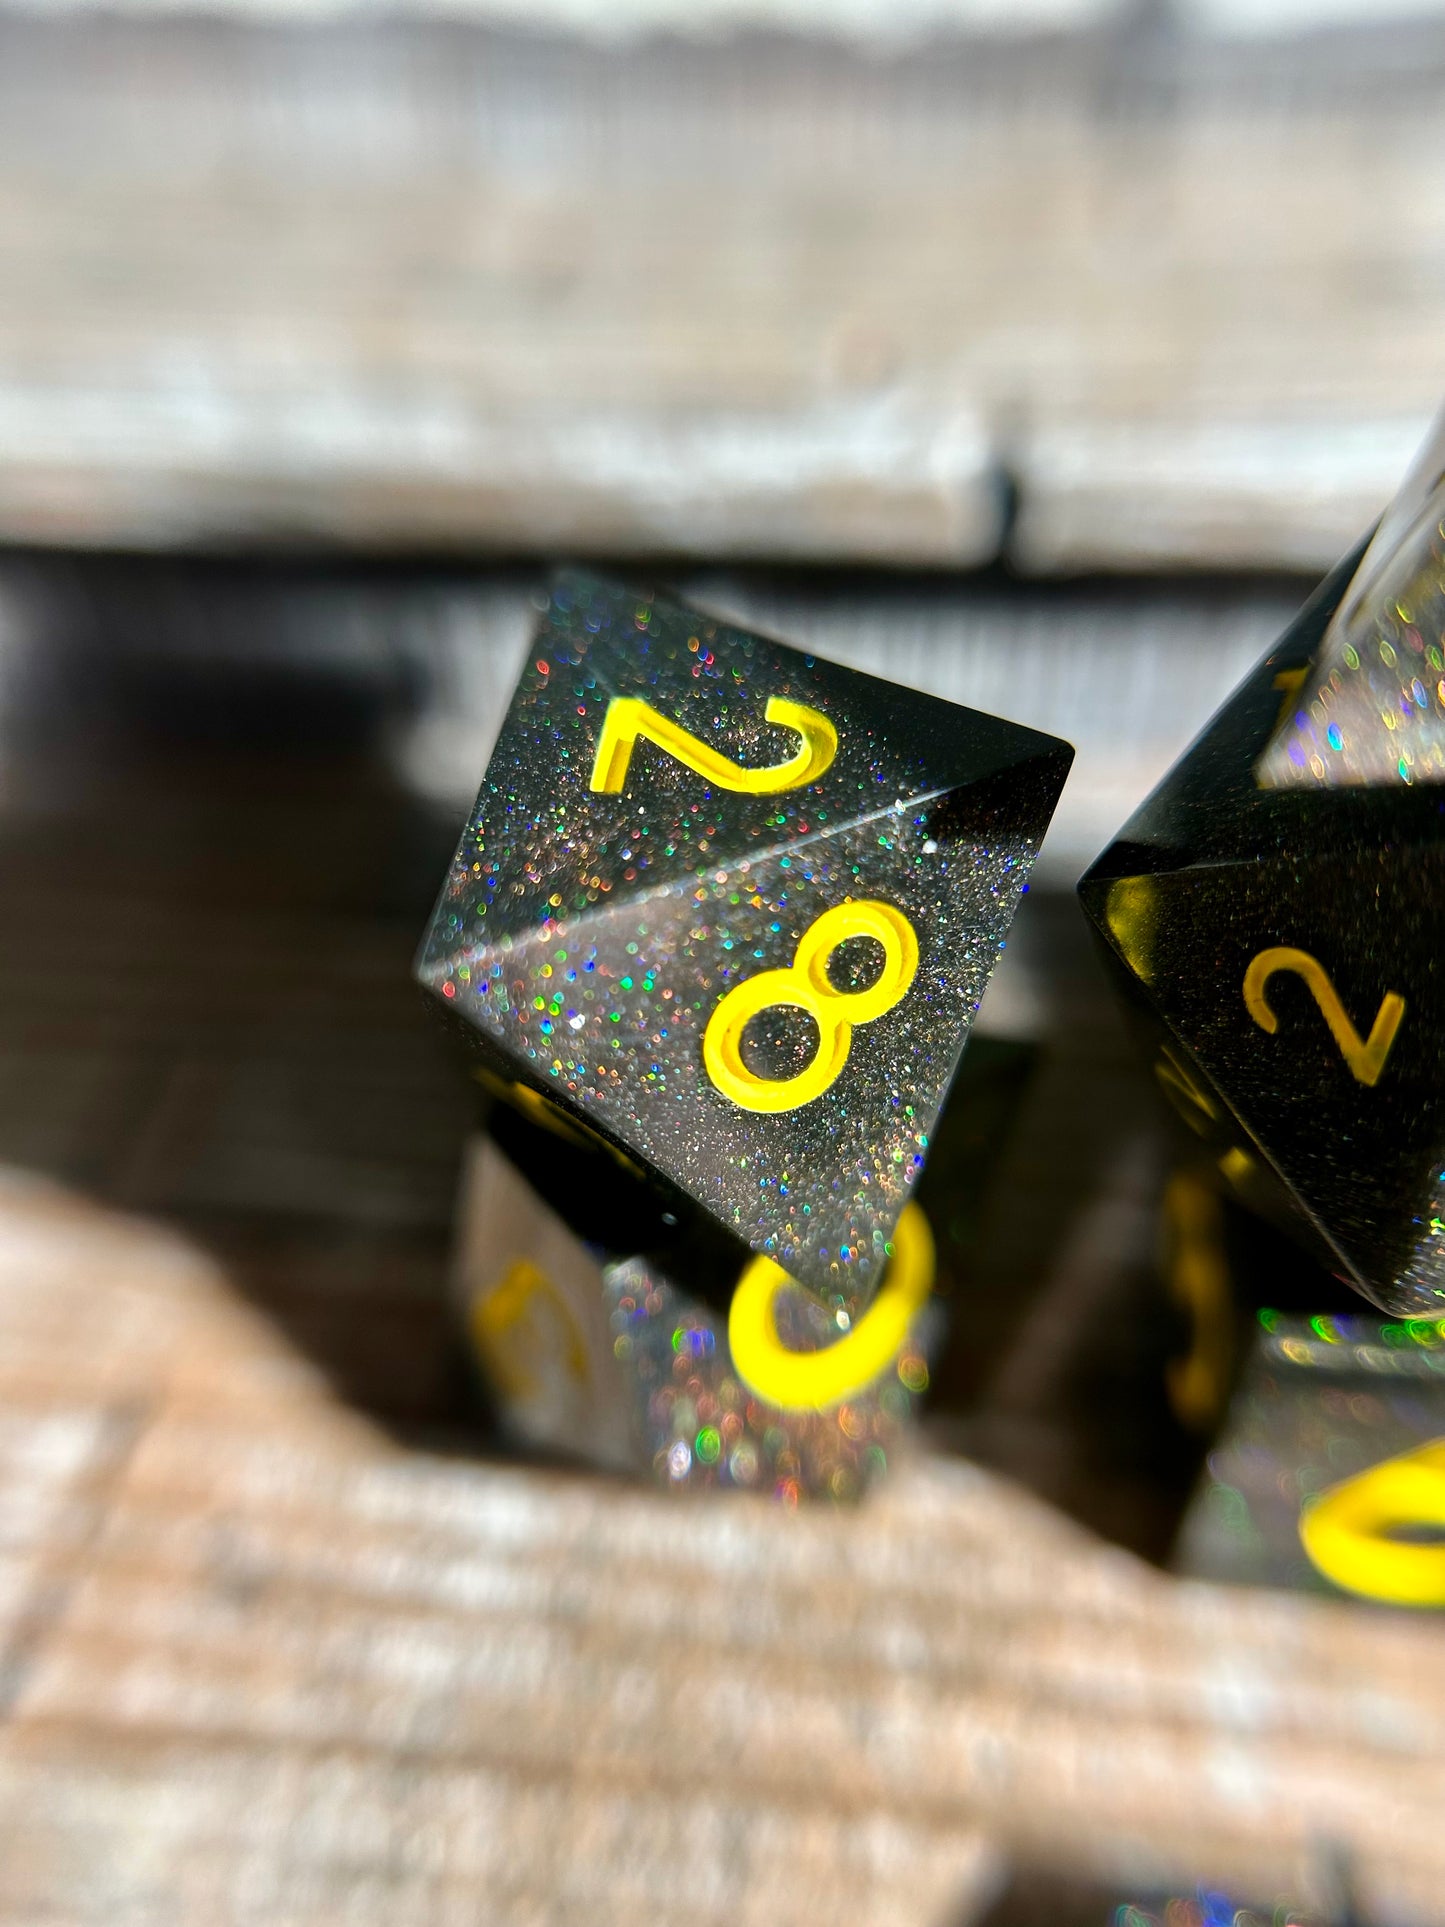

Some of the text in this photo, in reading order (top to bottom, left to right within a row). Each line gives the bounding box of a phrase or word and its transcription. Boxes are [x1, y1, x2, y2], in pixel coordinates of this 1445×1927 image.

[590, 697, 838, 794] 2
[703, 900, 919, 1113] 8
[1242, 947, 1405, 1086] 2
